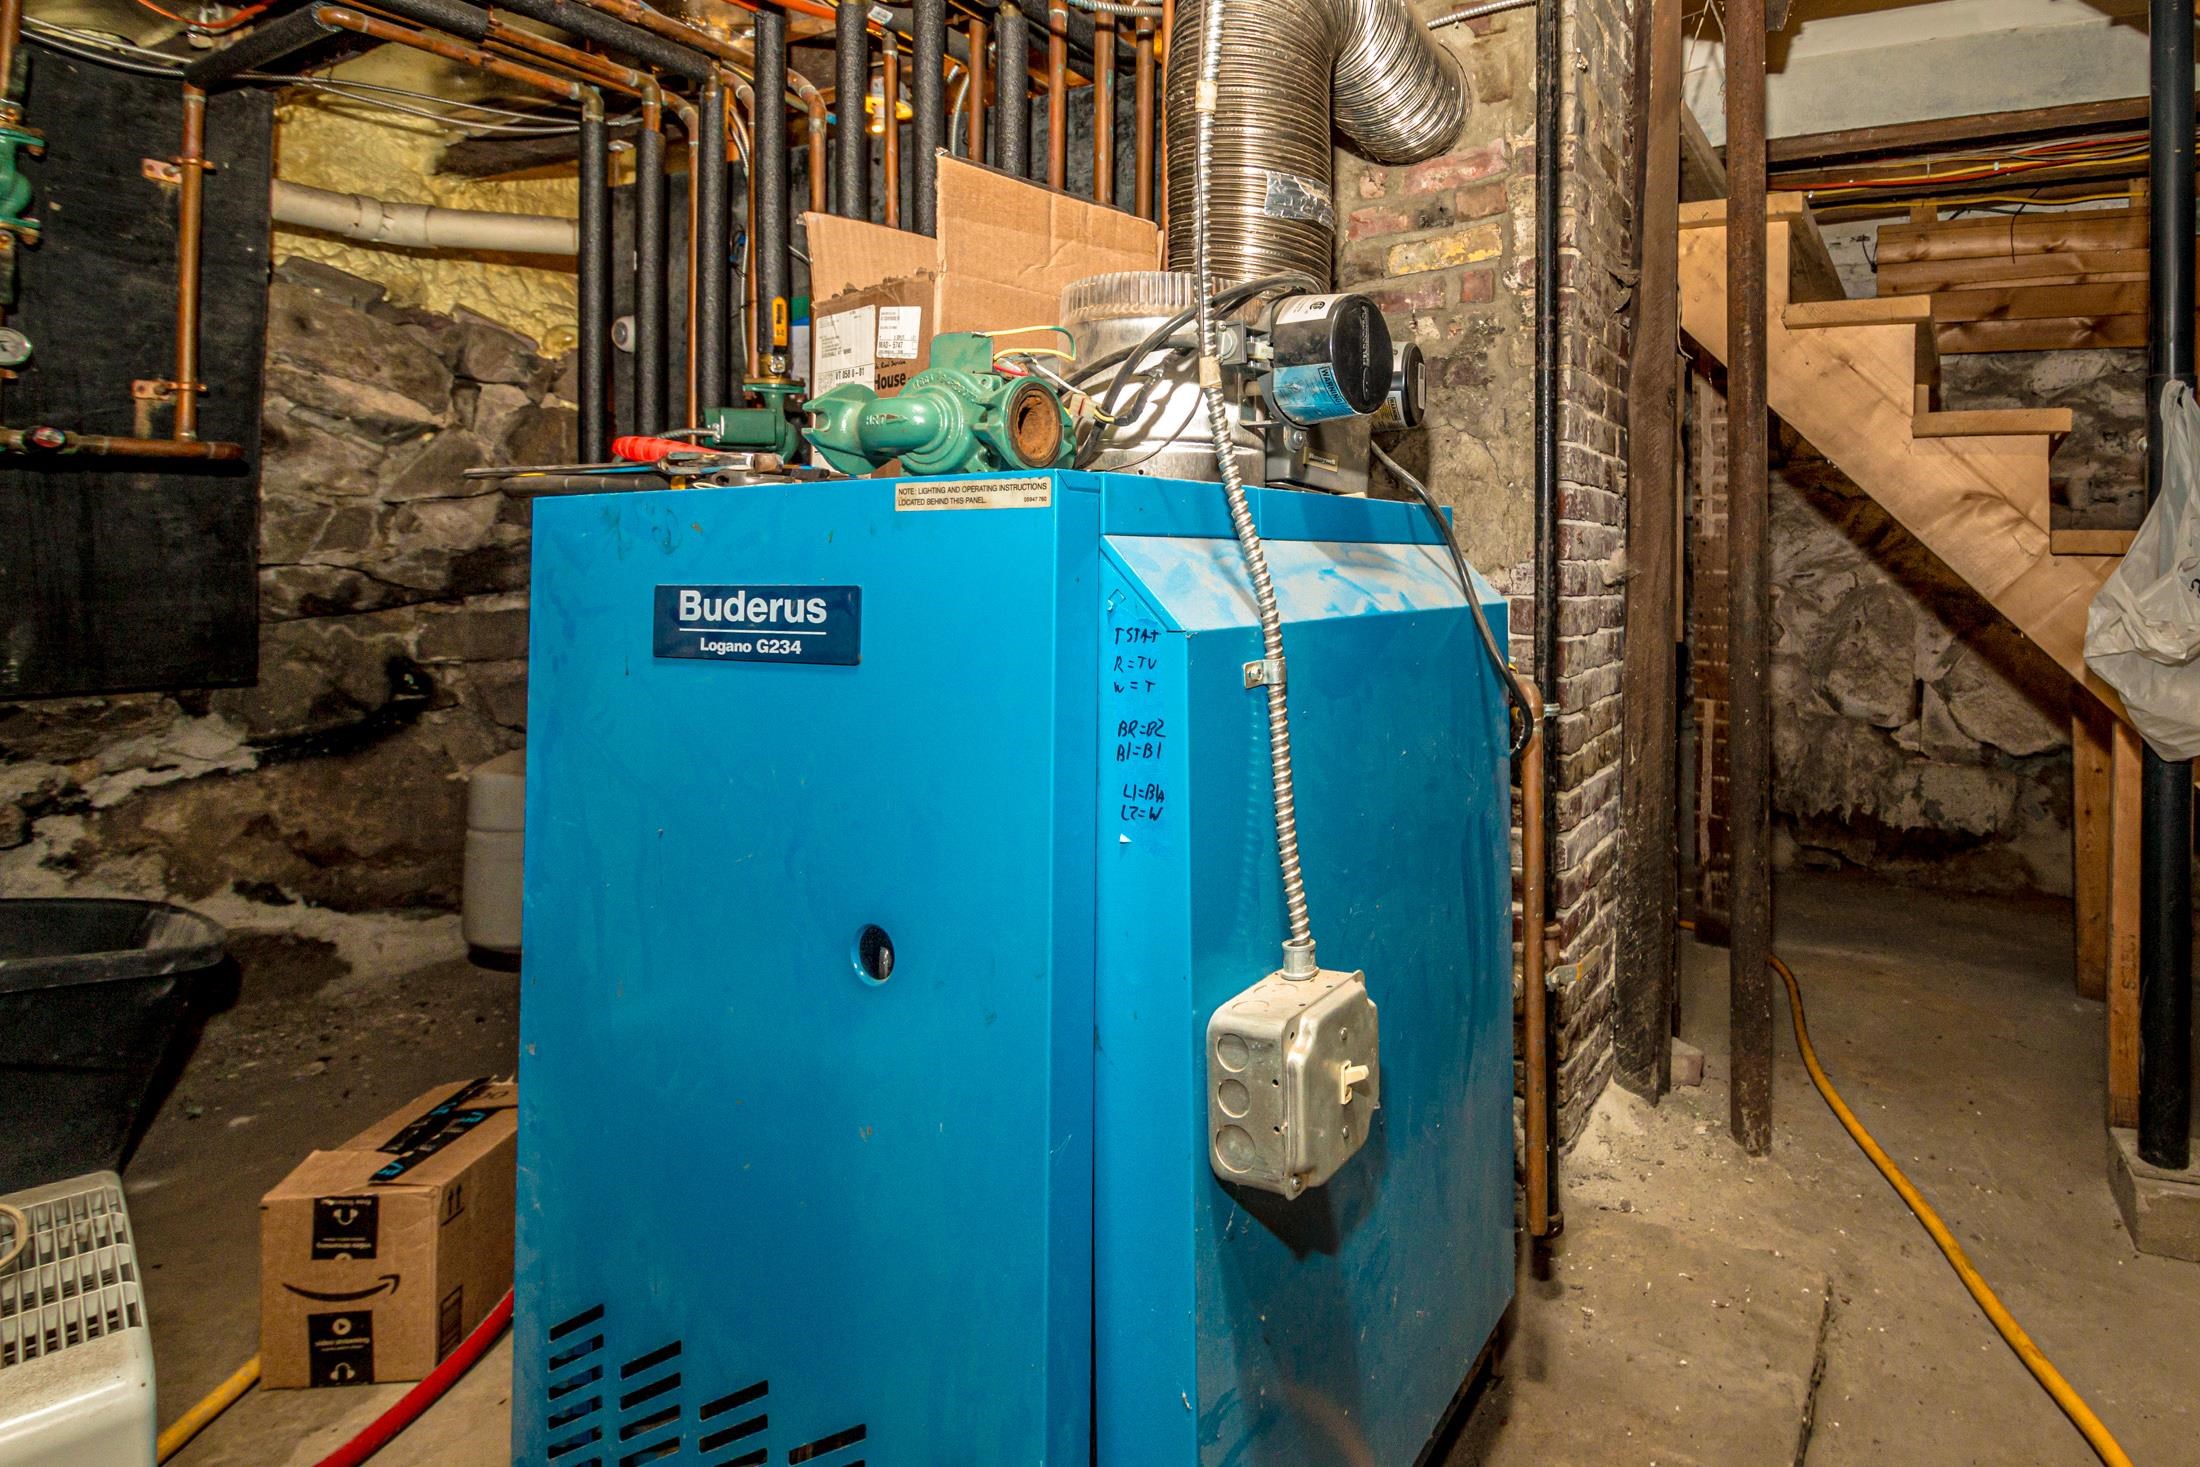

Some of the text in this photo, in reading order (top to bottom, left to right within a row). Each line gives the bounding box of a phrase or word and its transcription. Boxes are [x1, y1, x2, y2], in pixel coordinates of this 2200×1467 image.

[1321, 367, 1343, 404] WARNING
[898, 482, 1048, 496] NOTE: LIGHTING AND OPERATING INSTRUCTIONS
[898, 498, 926, 507] LOCATED
[926, 497, 950, 506] BEHIND
[949, 496, 965, 505] THIS
[679, 589, 828, 624] Buderus
[699, 637, 802, 656] Logano G234
